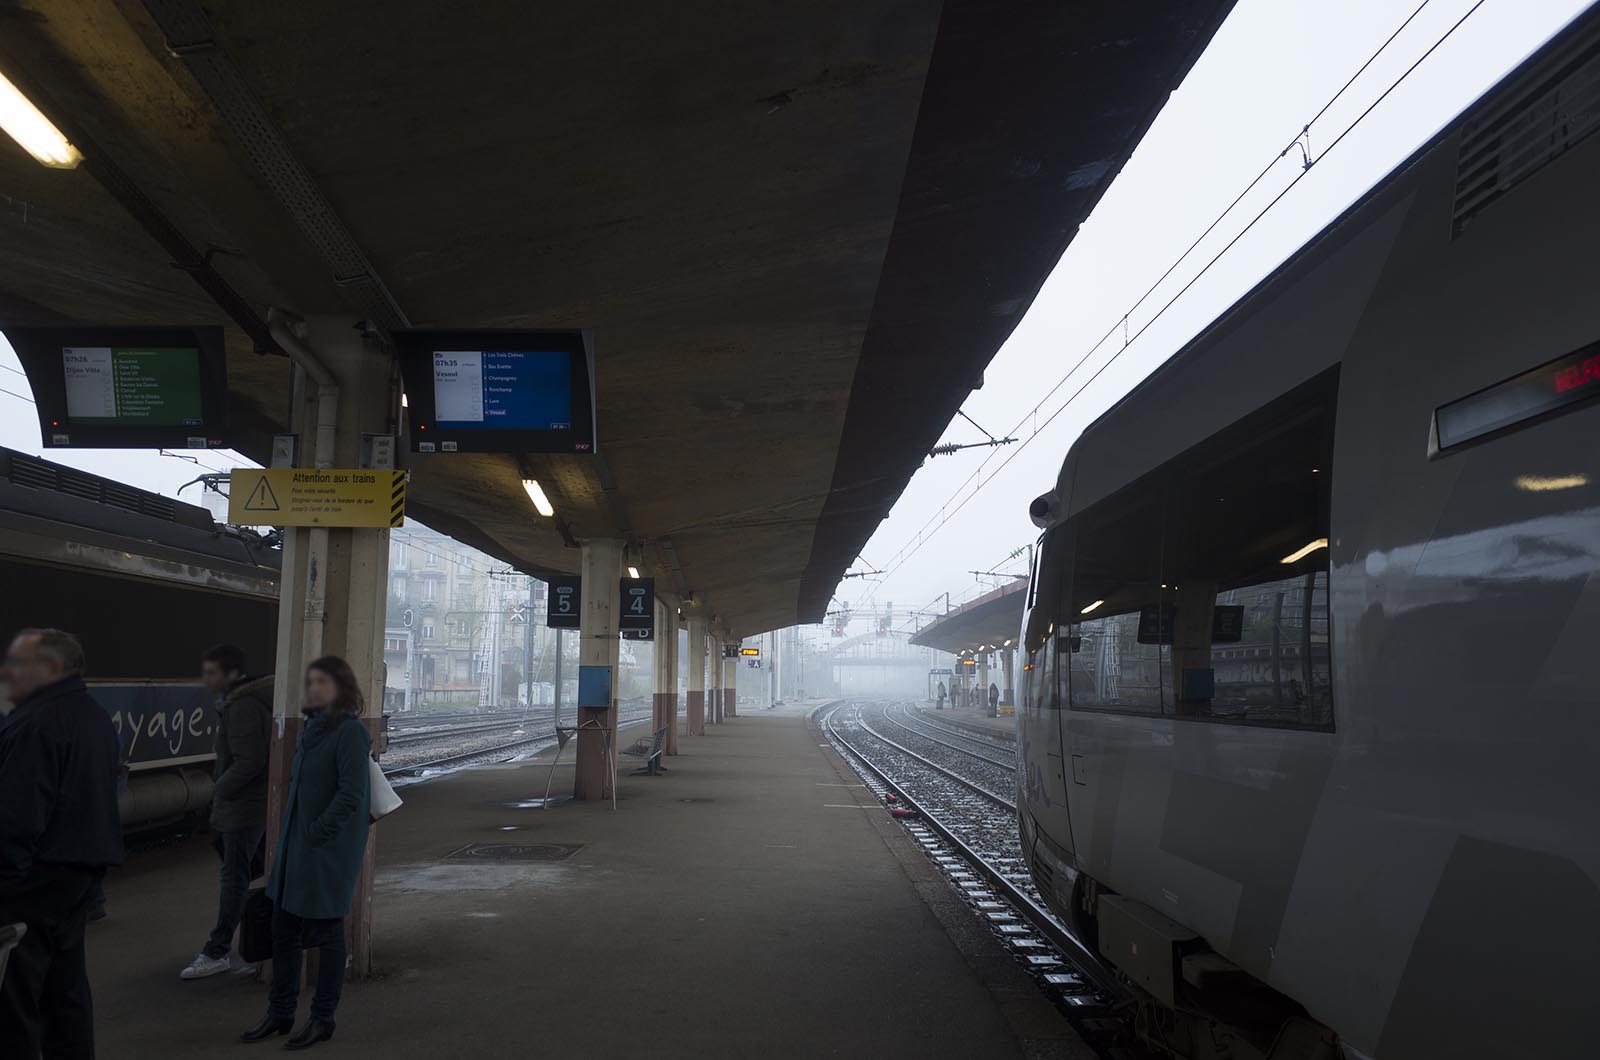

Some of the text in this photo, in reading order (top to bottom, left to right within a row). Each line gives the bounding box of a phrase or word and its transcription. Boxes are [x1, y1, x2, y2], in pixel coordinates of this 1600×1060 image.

[292, 472, 376, 484] Attention aux trains
[559, 594, 571, 613] 5
[631, 596, 644, 614] 4
